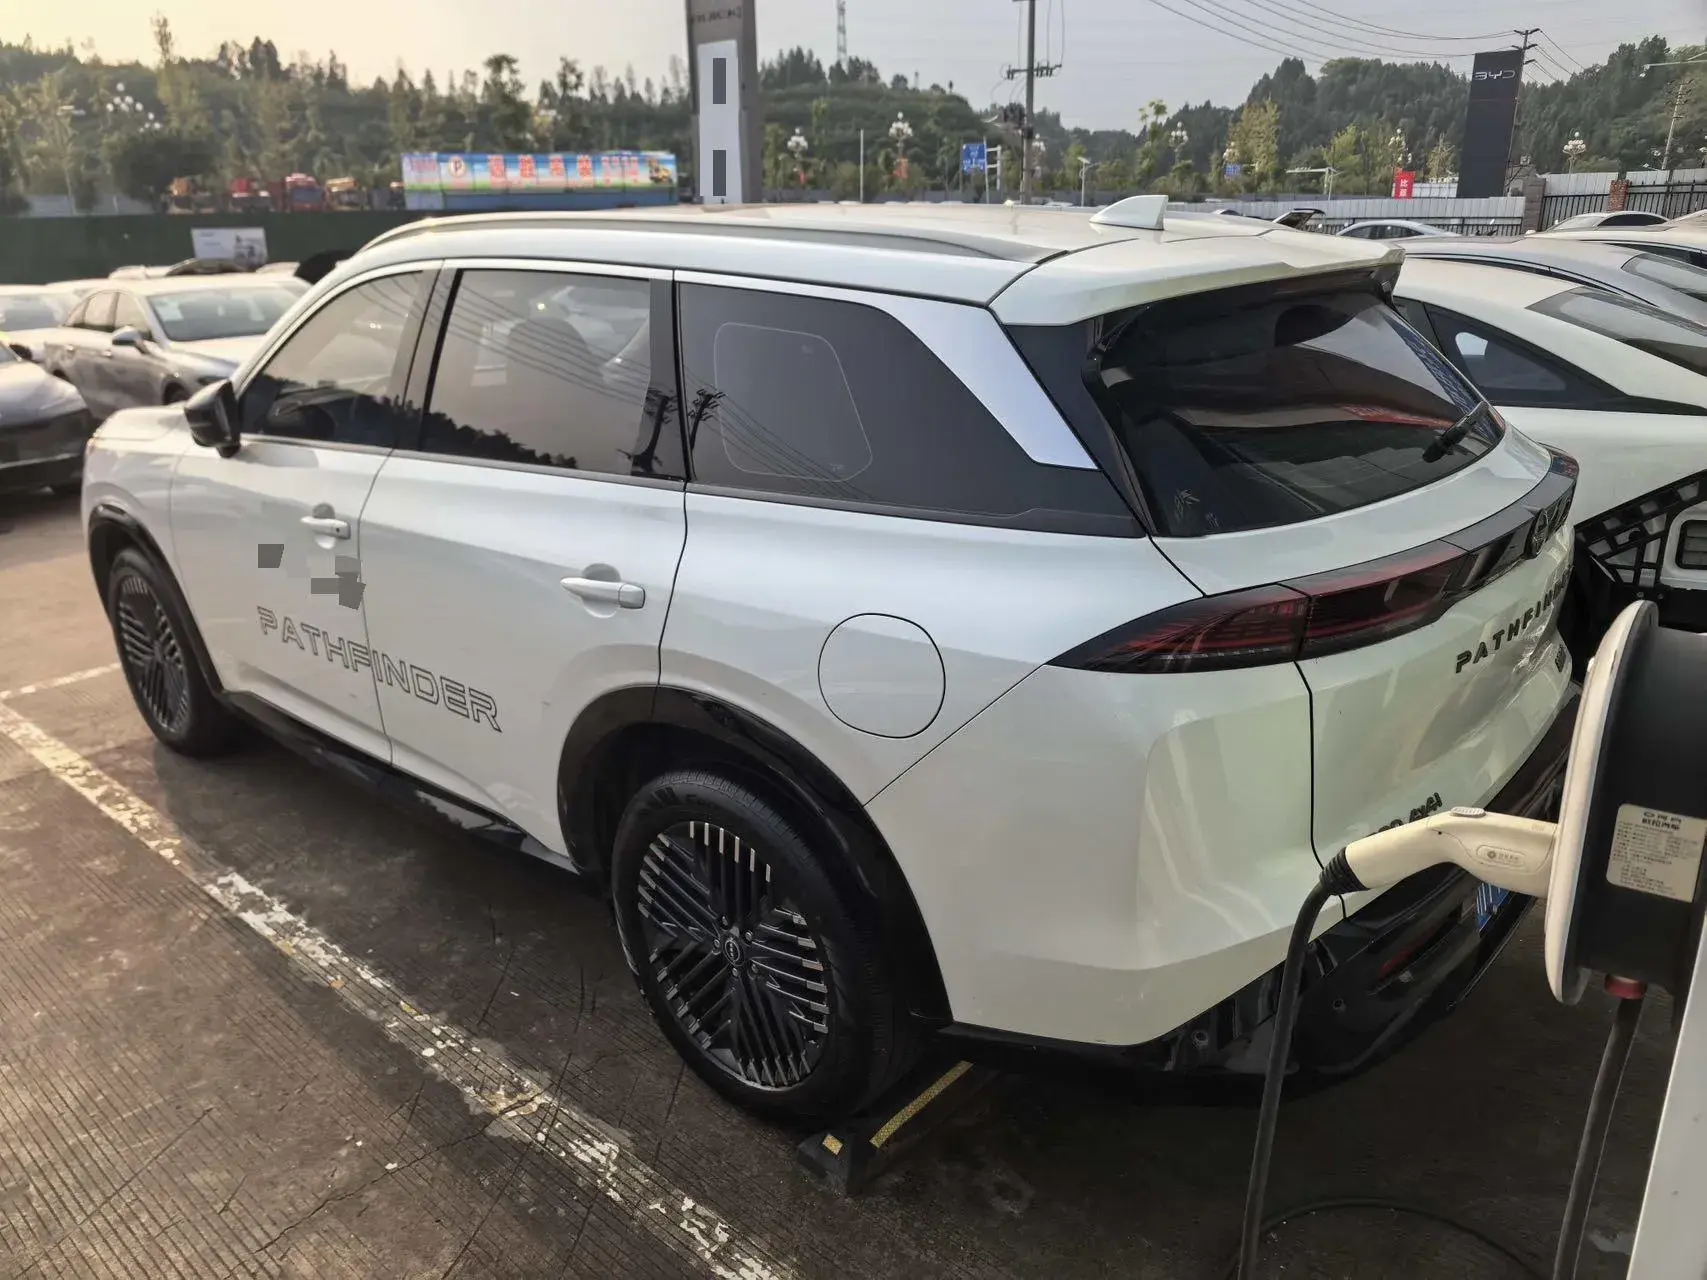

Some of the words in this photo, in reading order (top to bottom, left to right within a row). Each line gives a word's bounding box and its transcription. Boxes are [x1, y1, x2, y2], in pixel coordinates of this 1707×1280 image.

[1474, 69, 1516, 81] BYD
[257, 605, 502, 732] PATHFINDER
[1455, 564, 1573, 674] PATHFIN
